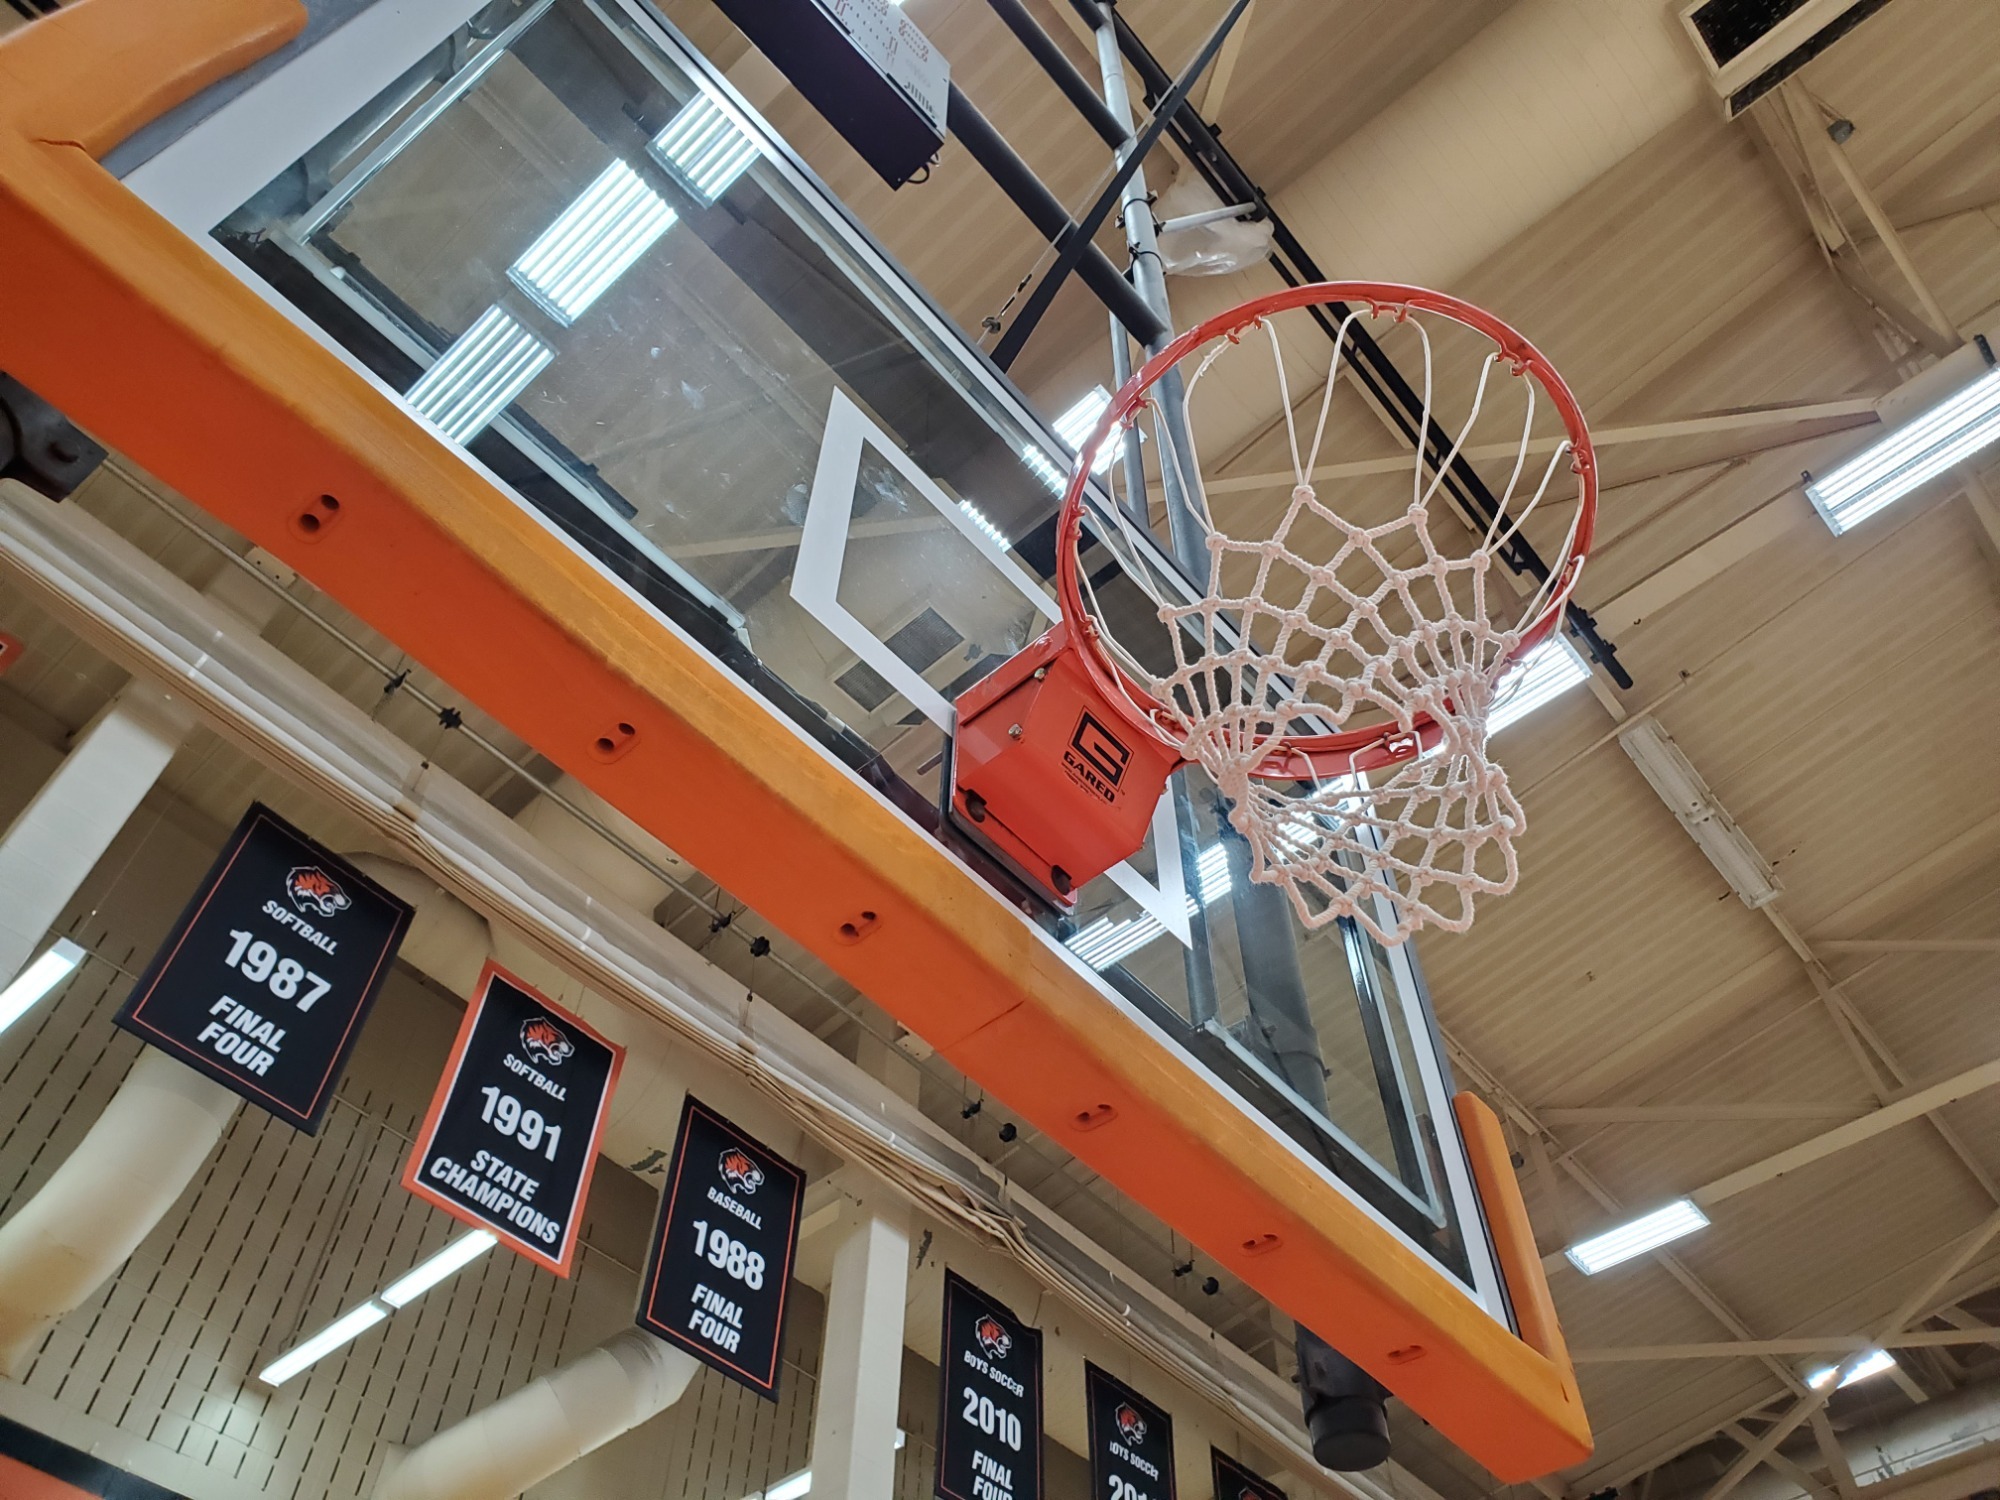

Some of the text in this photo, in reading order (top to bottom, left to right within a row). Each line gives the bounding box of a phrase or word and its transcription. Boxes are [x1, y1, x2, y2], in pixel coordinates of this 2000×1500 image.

[1063, 750, 1115, 803] GARED
[263, 900, 338, 956] SOFTBALL
[224, 929, 332, 1013] 1987
[197, 1021, 275, 1077] FOUR
[208, 995, 286, 1053] FINAL
[503, 1053, 566, 1102] SOFTBALL
[481, 1086, 562, 1162] 1991
[429, 1156, 560, 1244] CHAMPIONS
[470, 1149, 540, 1202] STATE
[706, 1186, 762, 1231] BASEBALL
[692, 1220, 766, 1291] 1988
[687, 1309, 741, 1354] FOUR
[691, 1283, 743, 1330] FINAL
[964, 1350, 1025, 1398] BOYS SOCCER
[962, 1387, 1022, 1452] 2010
[971, 1450, 1013, 1490] FINAL
